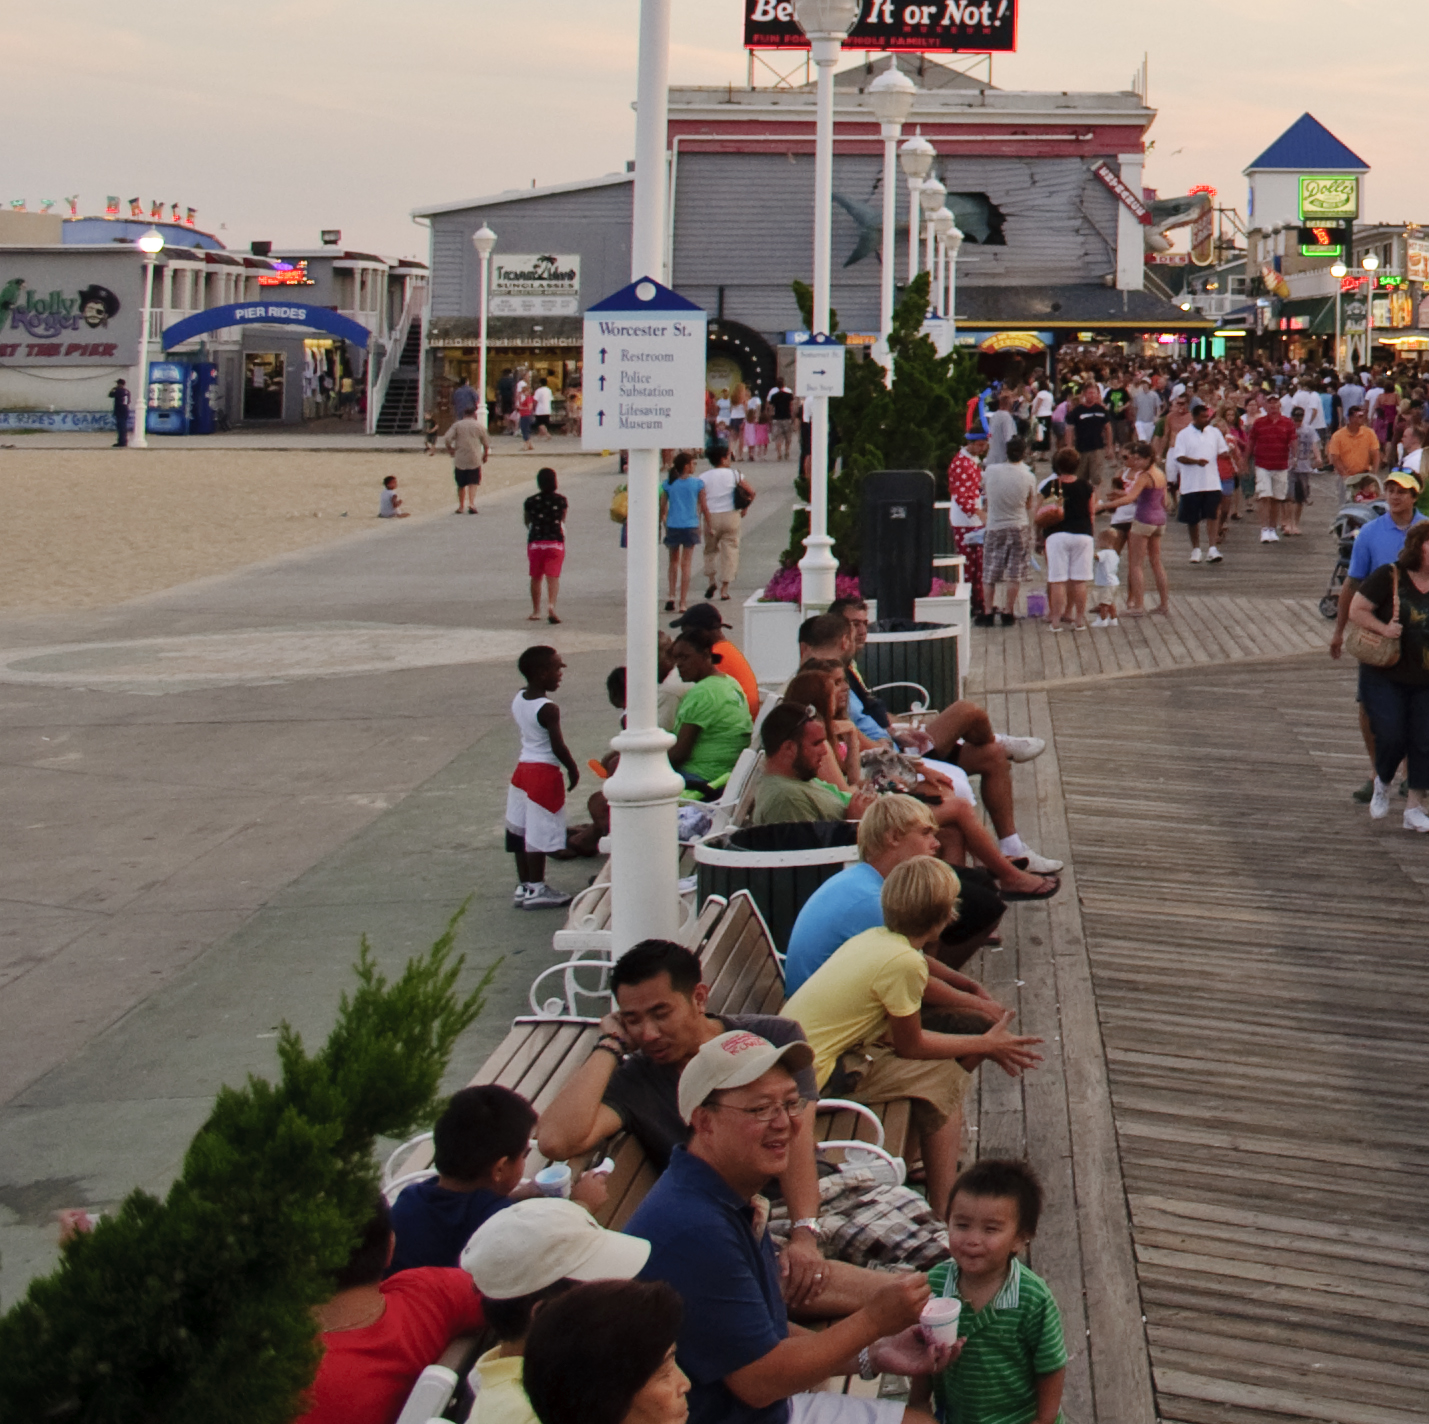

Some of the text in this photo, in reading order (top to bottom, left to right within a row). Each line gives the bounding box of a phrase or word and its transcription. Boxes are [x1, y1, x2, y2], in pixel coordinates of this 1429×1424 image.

[903, 5, 937, 25] or
[752, 34, 780, 43] FUN
[1380, 276, 1401, 285] SALT
[17, 290, 78, 315] Jolly
[235, 307, 306, 320] PIER RIDES
[10, 308, 84, 338] Roger
[599, 322, 692, 337] Worcester St.
[26, 343, 63, 357] THE
[64, 343, 118, 357] PIER
[621, 349, 674, 362] Restroom
[620, 371, 651, 384] Police
[619, 384, 674, 397] Substation
[619, 403, 671, 418] Lifesaving
[619, 418, 663, 429] Museum
